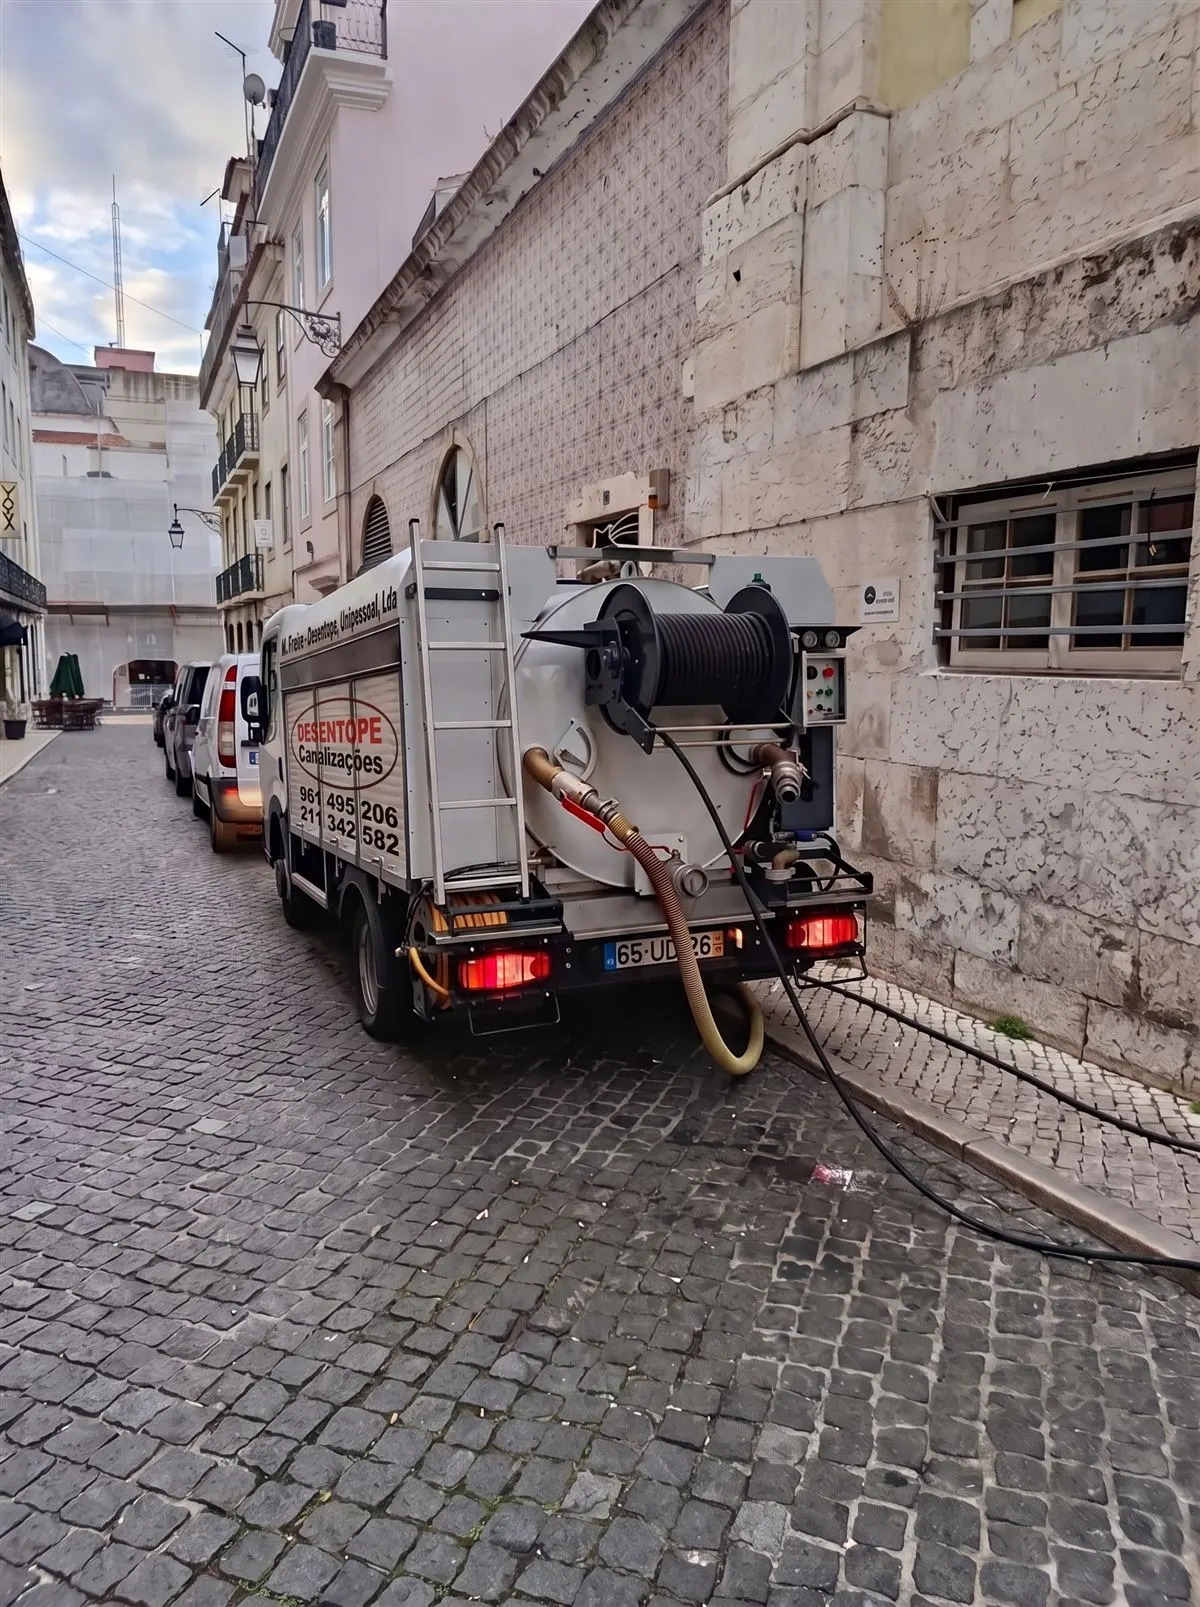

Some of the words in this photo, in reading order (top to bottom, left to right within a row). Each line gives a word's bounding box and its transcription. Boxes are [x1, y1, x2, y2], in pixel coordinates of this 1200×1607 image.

[288, 632, 304, 653] Freire
[307, 619, 339, 647] Desentope,
[340, 593, 380, 632] Unipessoal,
[382, 585, 397, 613] Lda
[297, 716, 382, 744] DESENTOPE
[298, 744, 383, 775] Canalizações
[300, 786, 320, 806] 961
[327, 793, 355, 816] 495
[361, 800, 398, 829] 206
[300, 806, 321, 827] 211
[328, 814, 356, 840] 342
[362, 826, 399, 856] 582
